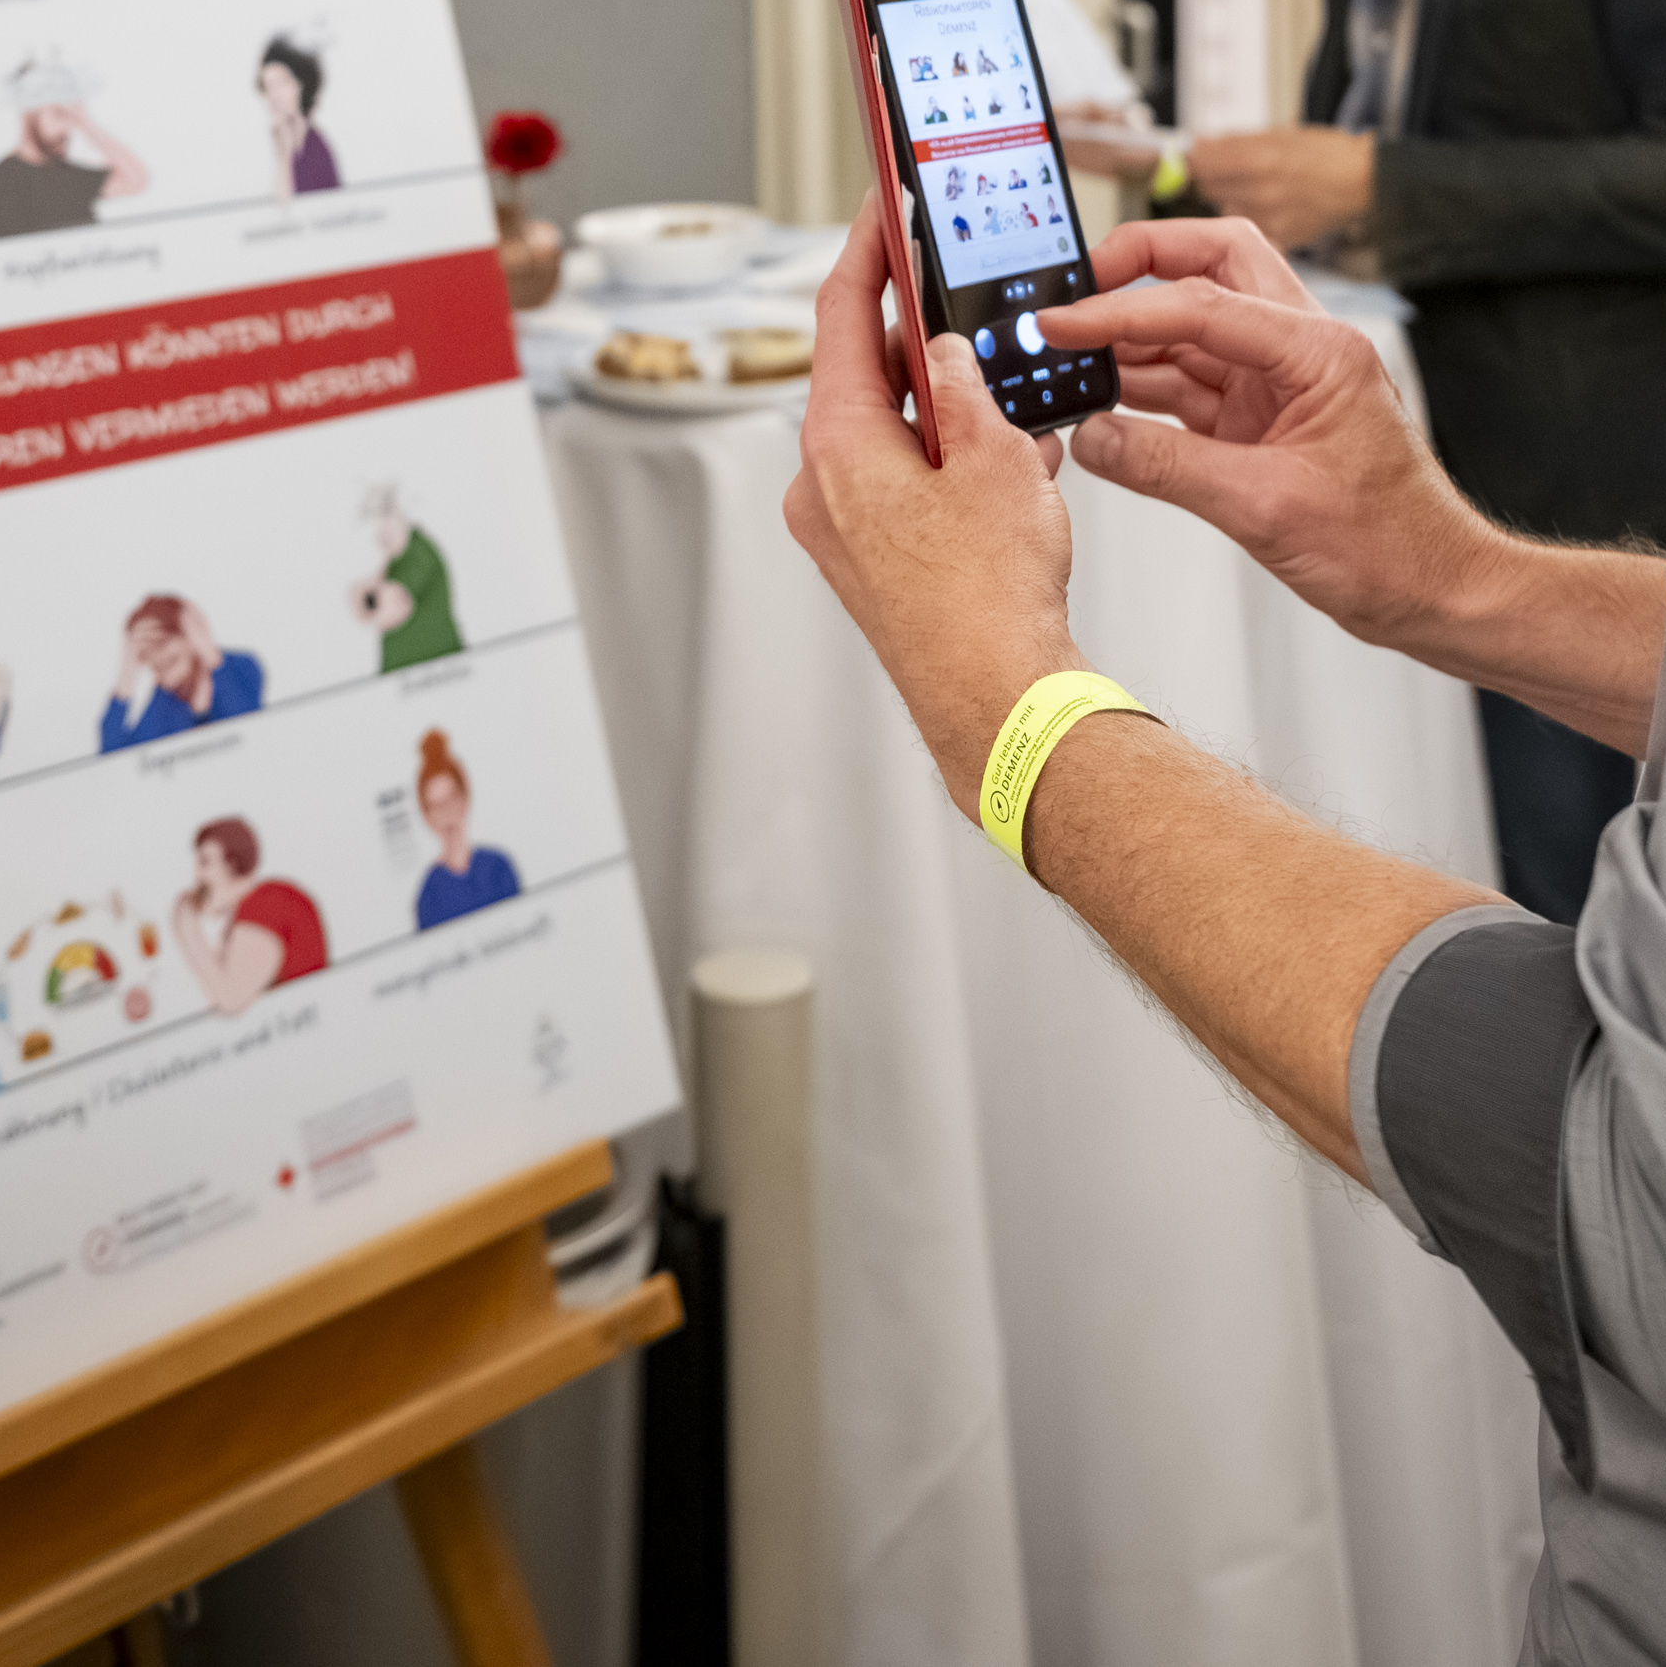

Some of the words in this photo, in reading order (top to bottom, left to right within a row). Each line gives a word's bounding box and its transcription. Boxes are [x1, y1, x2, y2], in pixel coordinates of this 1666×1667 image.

[992, 762, 1004, 785] Gut
[999, 727, 1020, 761] leben
[1019, 704, 1035, 725] mit
[1002, 732, 1032, 791] DEMENZ
